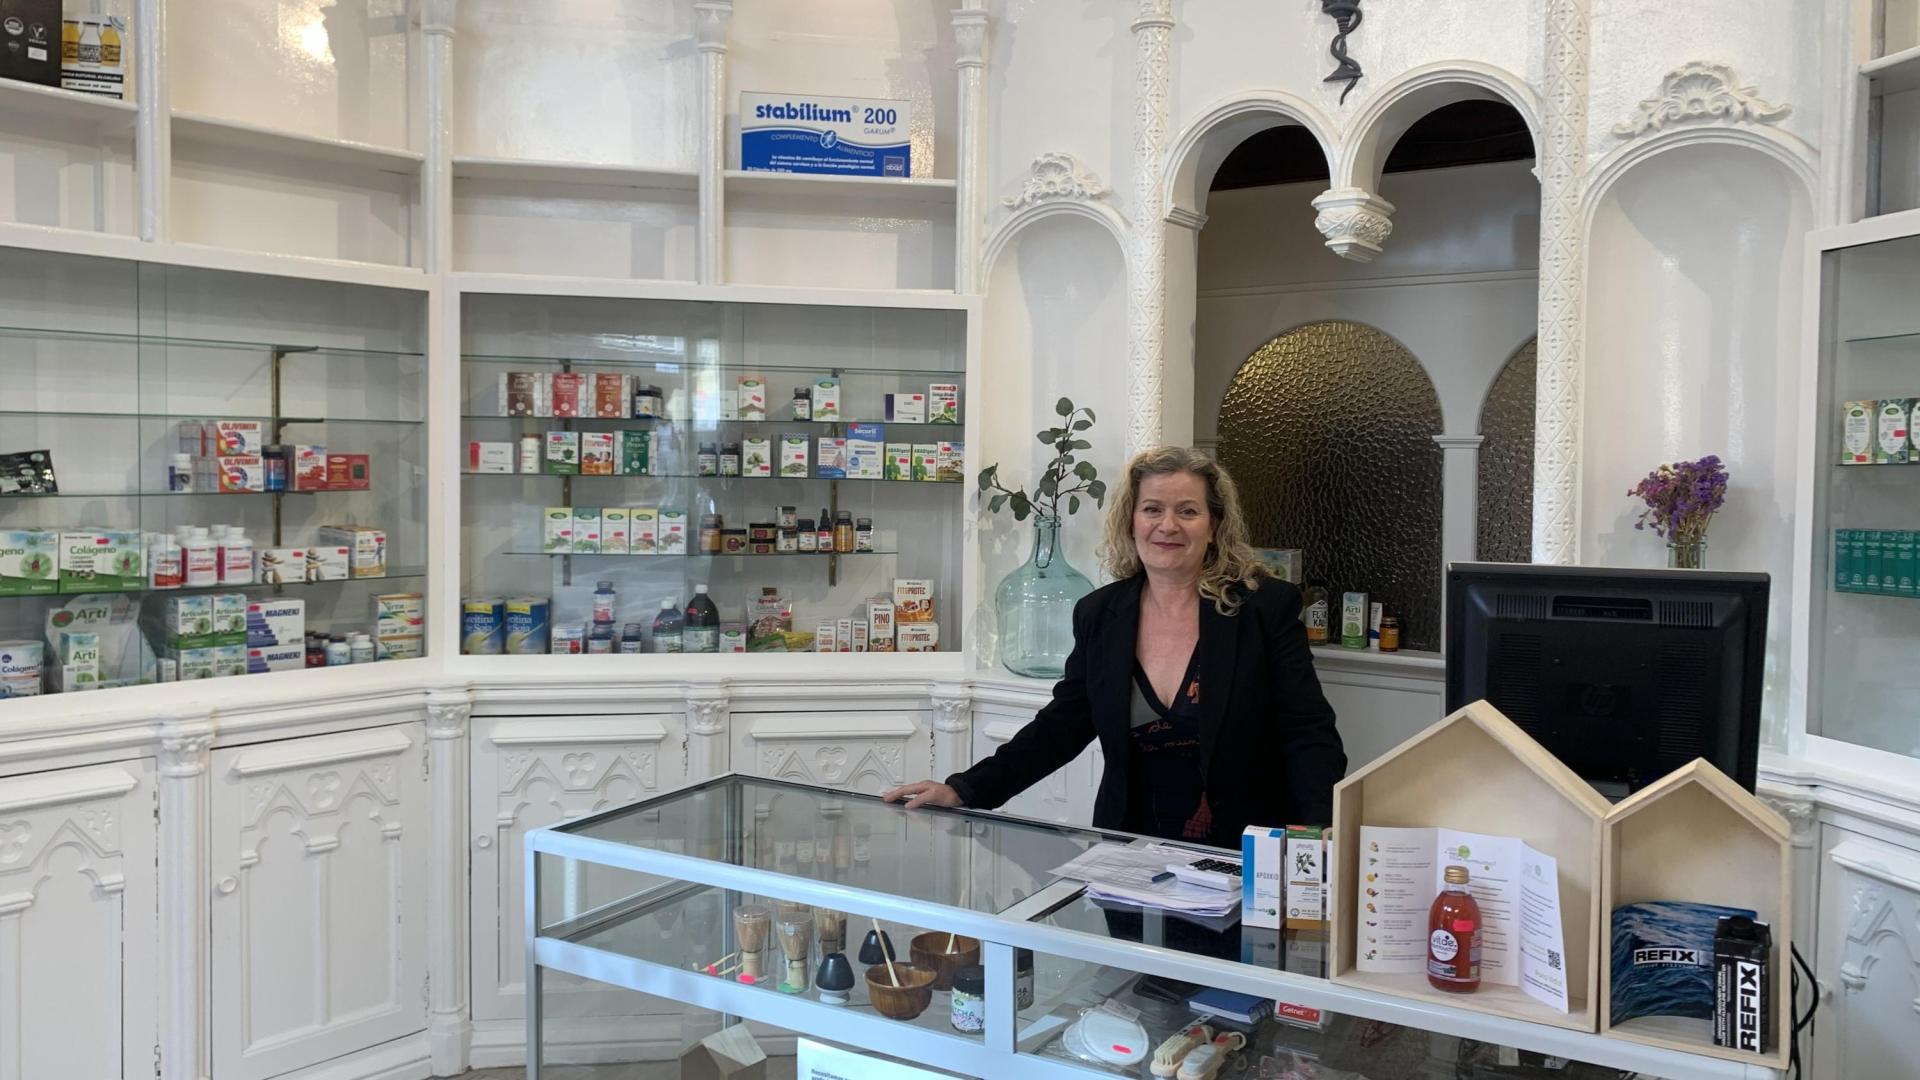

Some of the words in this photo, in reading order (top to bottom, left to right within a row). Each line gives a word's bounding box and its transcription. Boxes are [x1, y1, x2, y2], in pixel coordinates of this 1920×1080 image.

[864, 107, 897, 125] 200
[771, 134, 819, 142] COMPLEMENTO
[70, 545, 117, 556] Colágeno
[76, 607, 108, 620] Arti
[874, 613, 890, 624] PINO
[73, 649, 96, 660] Arti
[1636, 949, 1696, 963] REFIX
[1740, 965, 1757, 1051] REFIX
